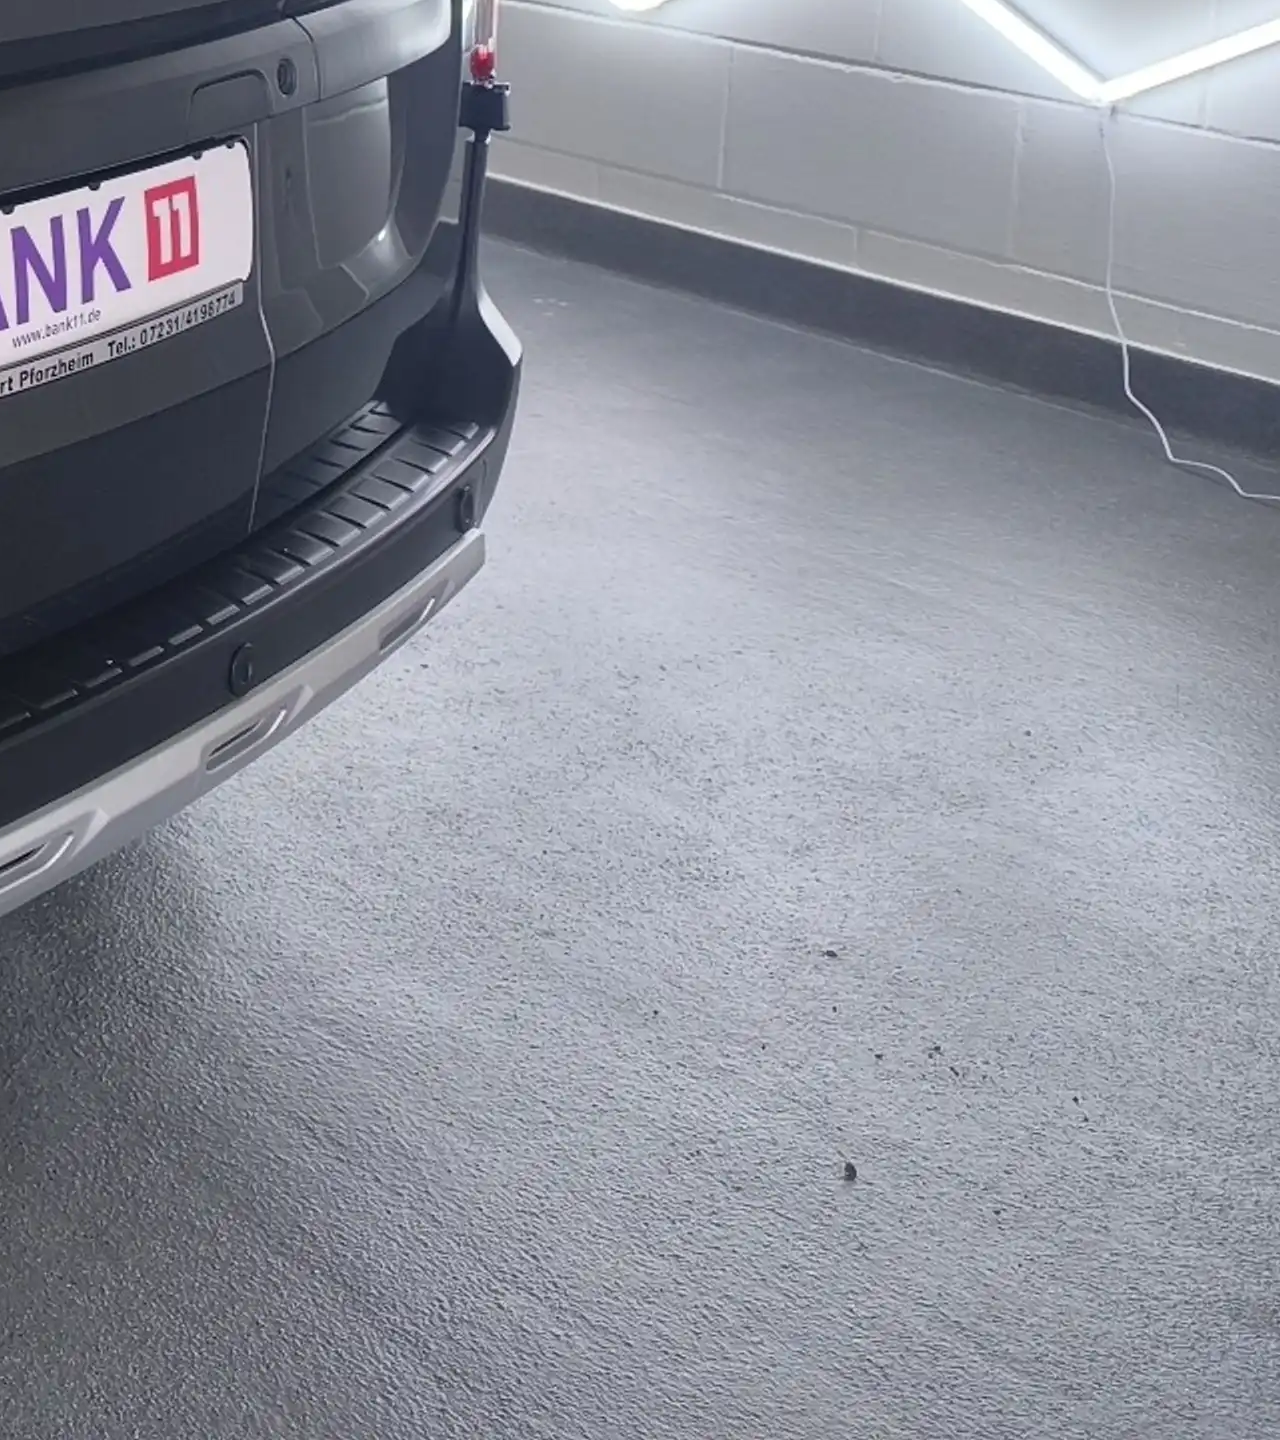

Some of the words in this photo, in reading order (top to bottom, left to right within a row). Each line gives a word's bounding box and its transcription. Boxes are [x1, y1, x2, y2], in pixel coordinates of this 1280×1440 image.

[151, 189, 195, 267] 11
[11, 307, 102, 349] www.bank11.de
[18, 352, 94, 388] Pforzheim
[107, 336, 136, 357] Tel.:
